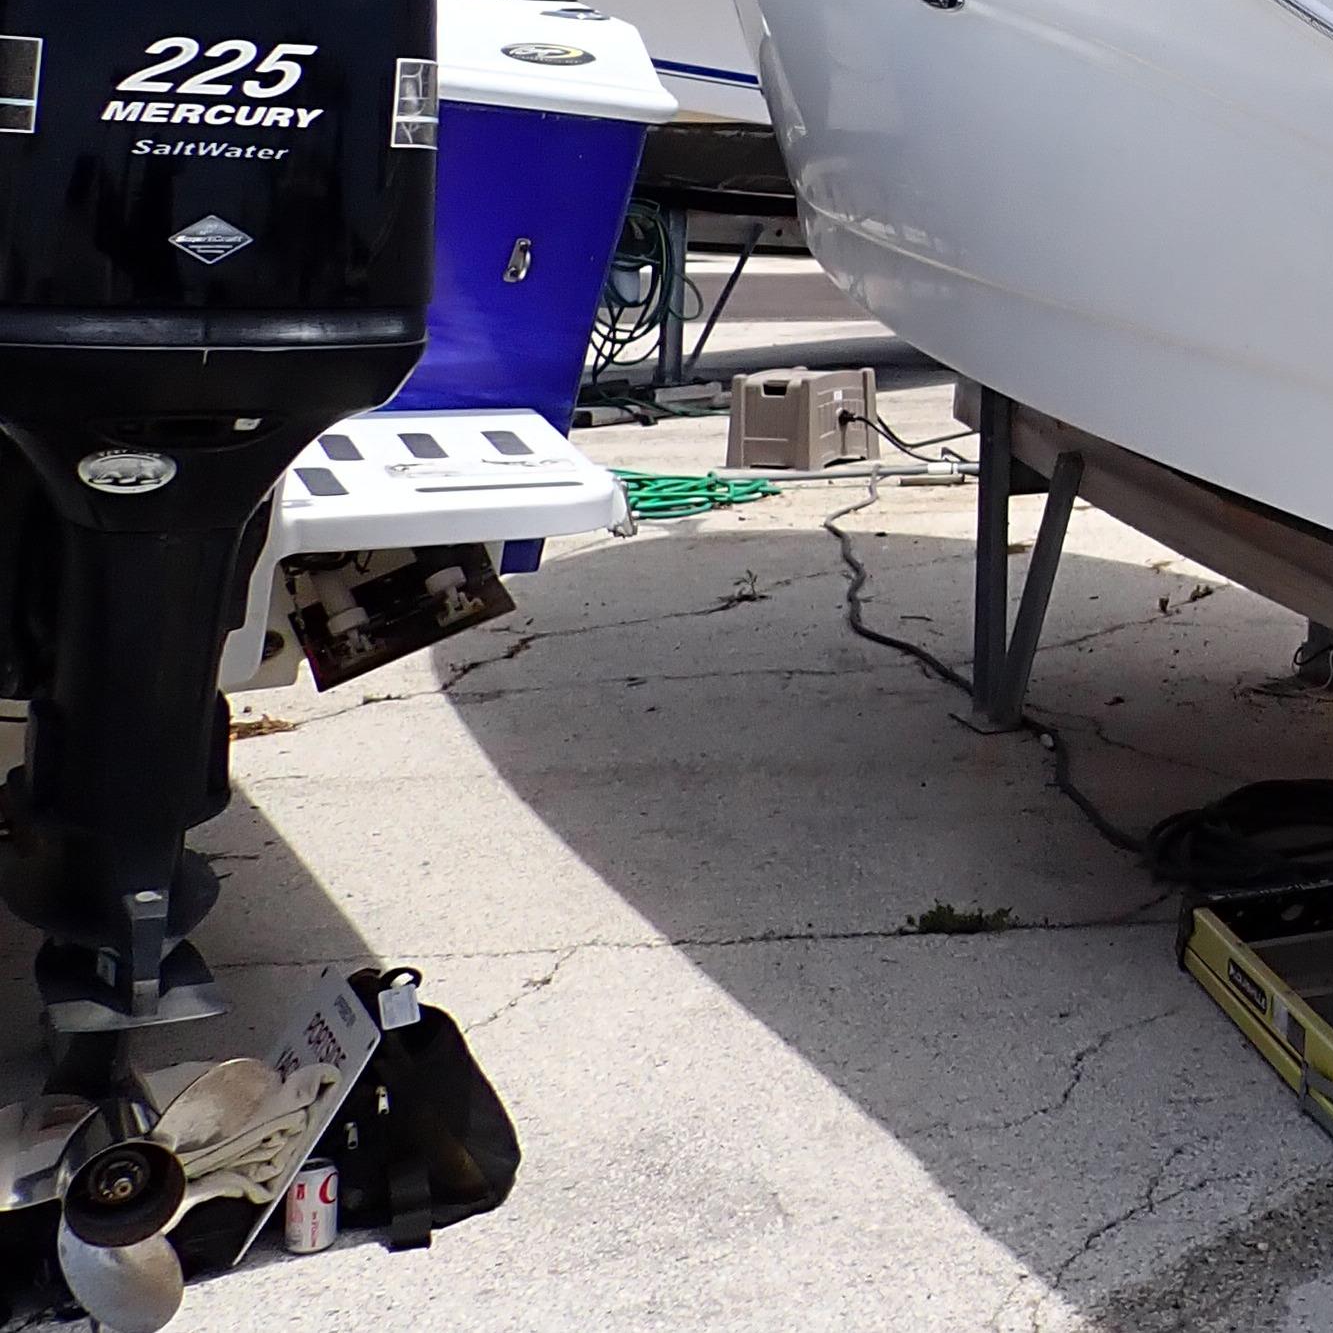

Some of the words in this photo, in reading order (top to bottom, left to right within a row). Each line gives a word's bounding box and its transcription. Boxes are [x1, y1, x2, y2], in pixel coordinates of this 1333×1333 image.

[115, 36, 319, 99] 225
[100, 100, 325, 128] MERCURY
[131, 139, 290, 160] SaltWater
